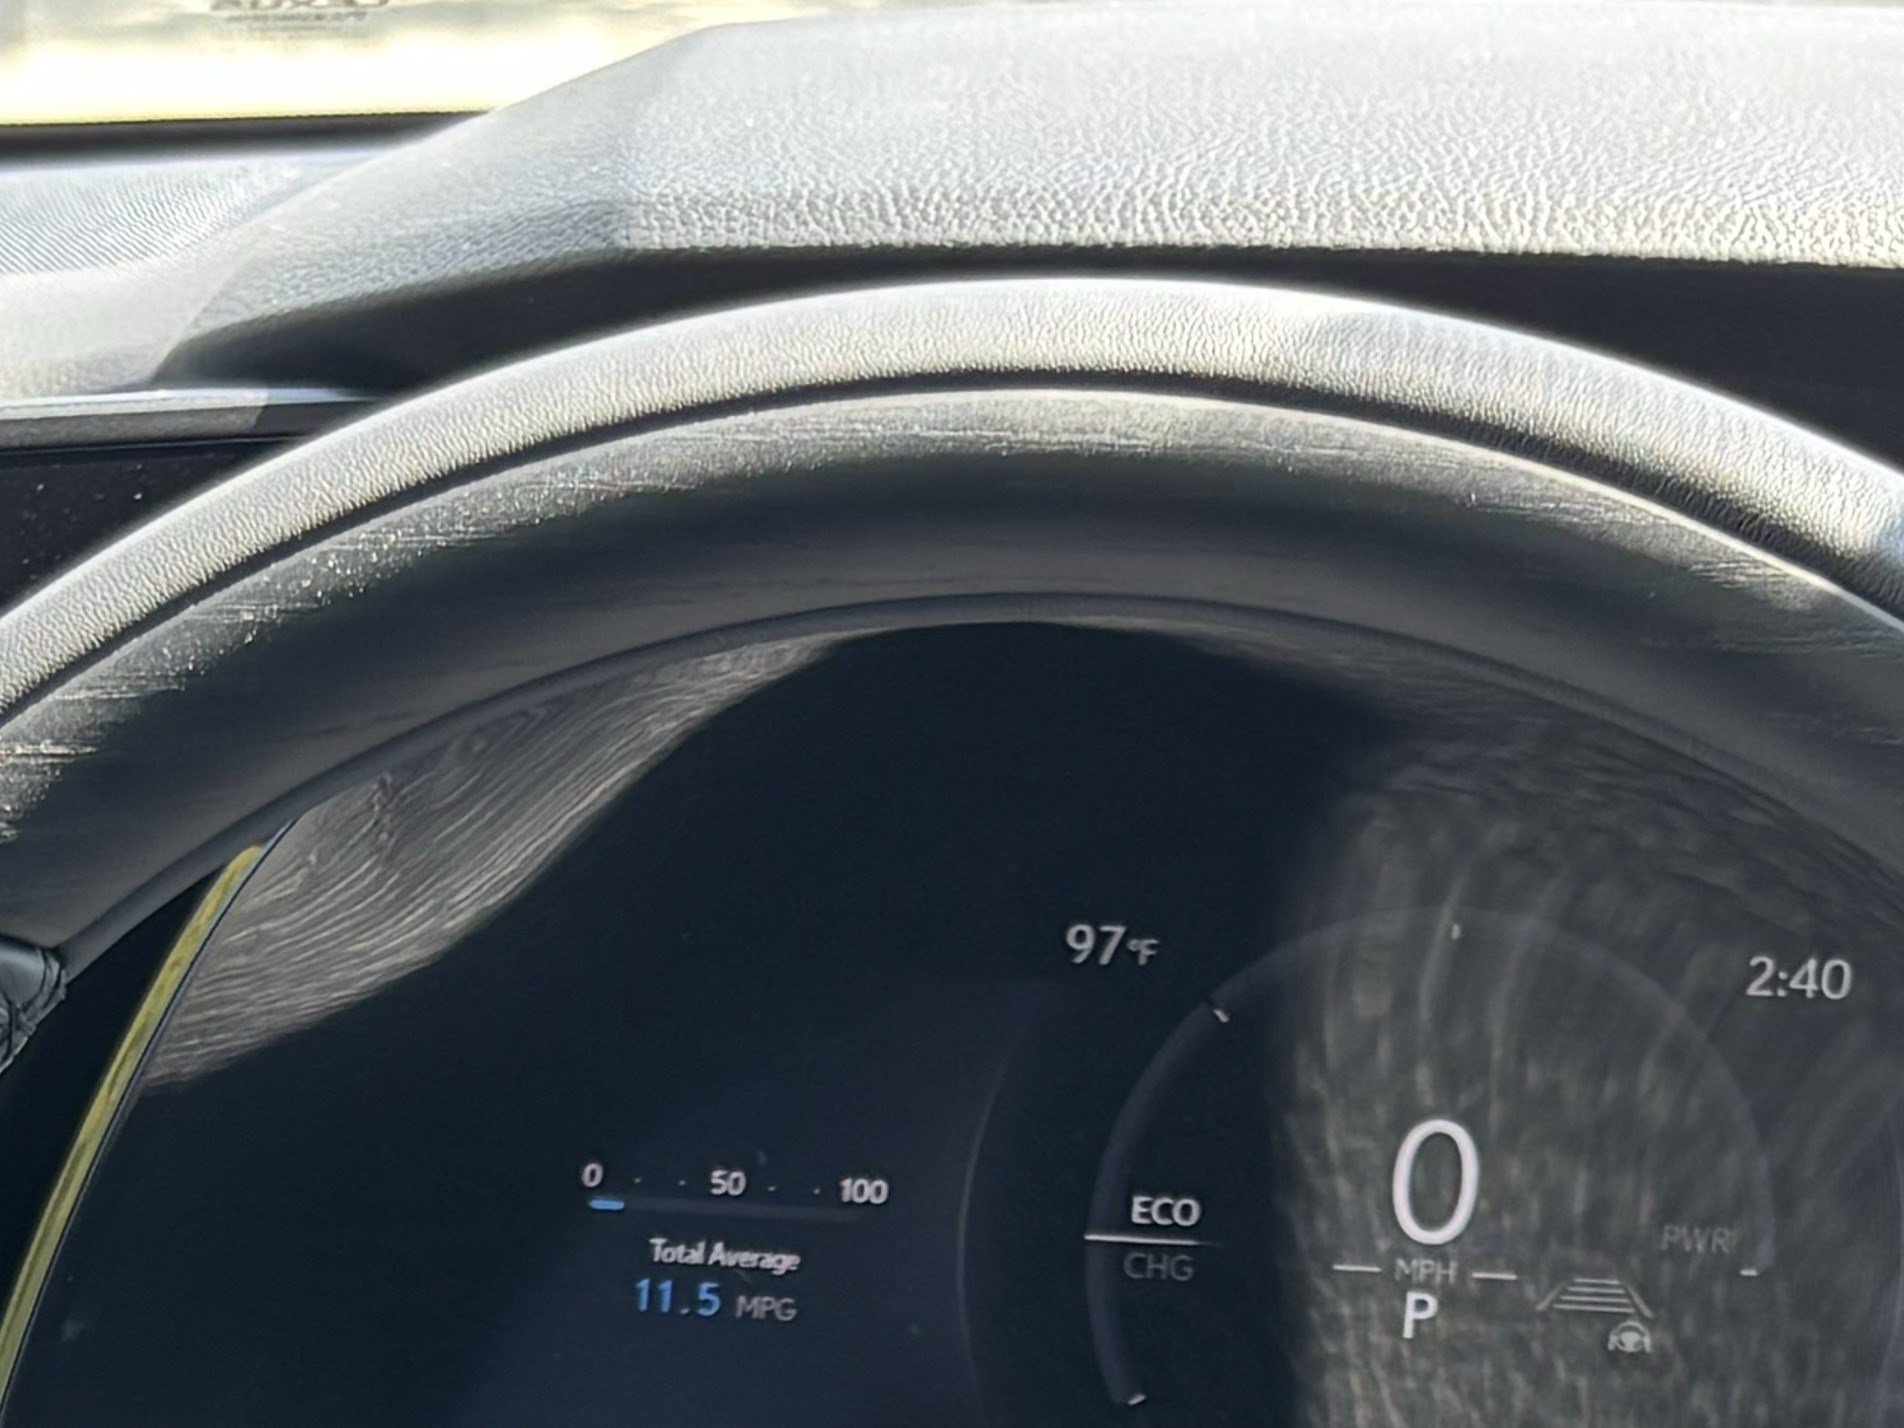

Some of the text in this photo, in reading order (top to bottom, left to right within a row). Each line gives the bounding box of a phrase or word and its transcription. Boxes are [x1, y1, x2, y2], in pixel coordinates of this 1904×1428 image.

[1745, 954, 1853, 1000] 2:40
[582, 1163, 889, 1205] 0 50 100
[1391, 1117, 1480, 1246] 0
[1131, 1195, 1202, 1227] ECO
[648, 1236, 801, 1277] Total Average
[1659, 1225, 1733, 1255] PWR
[1123, 1251, 1195, 1283] CHG
[1394, 1257, 1457, 1286] MPH
[635, 1278, 798, 1322] 11.5 MPG
[1402, 1292, 1438, 1341] P
